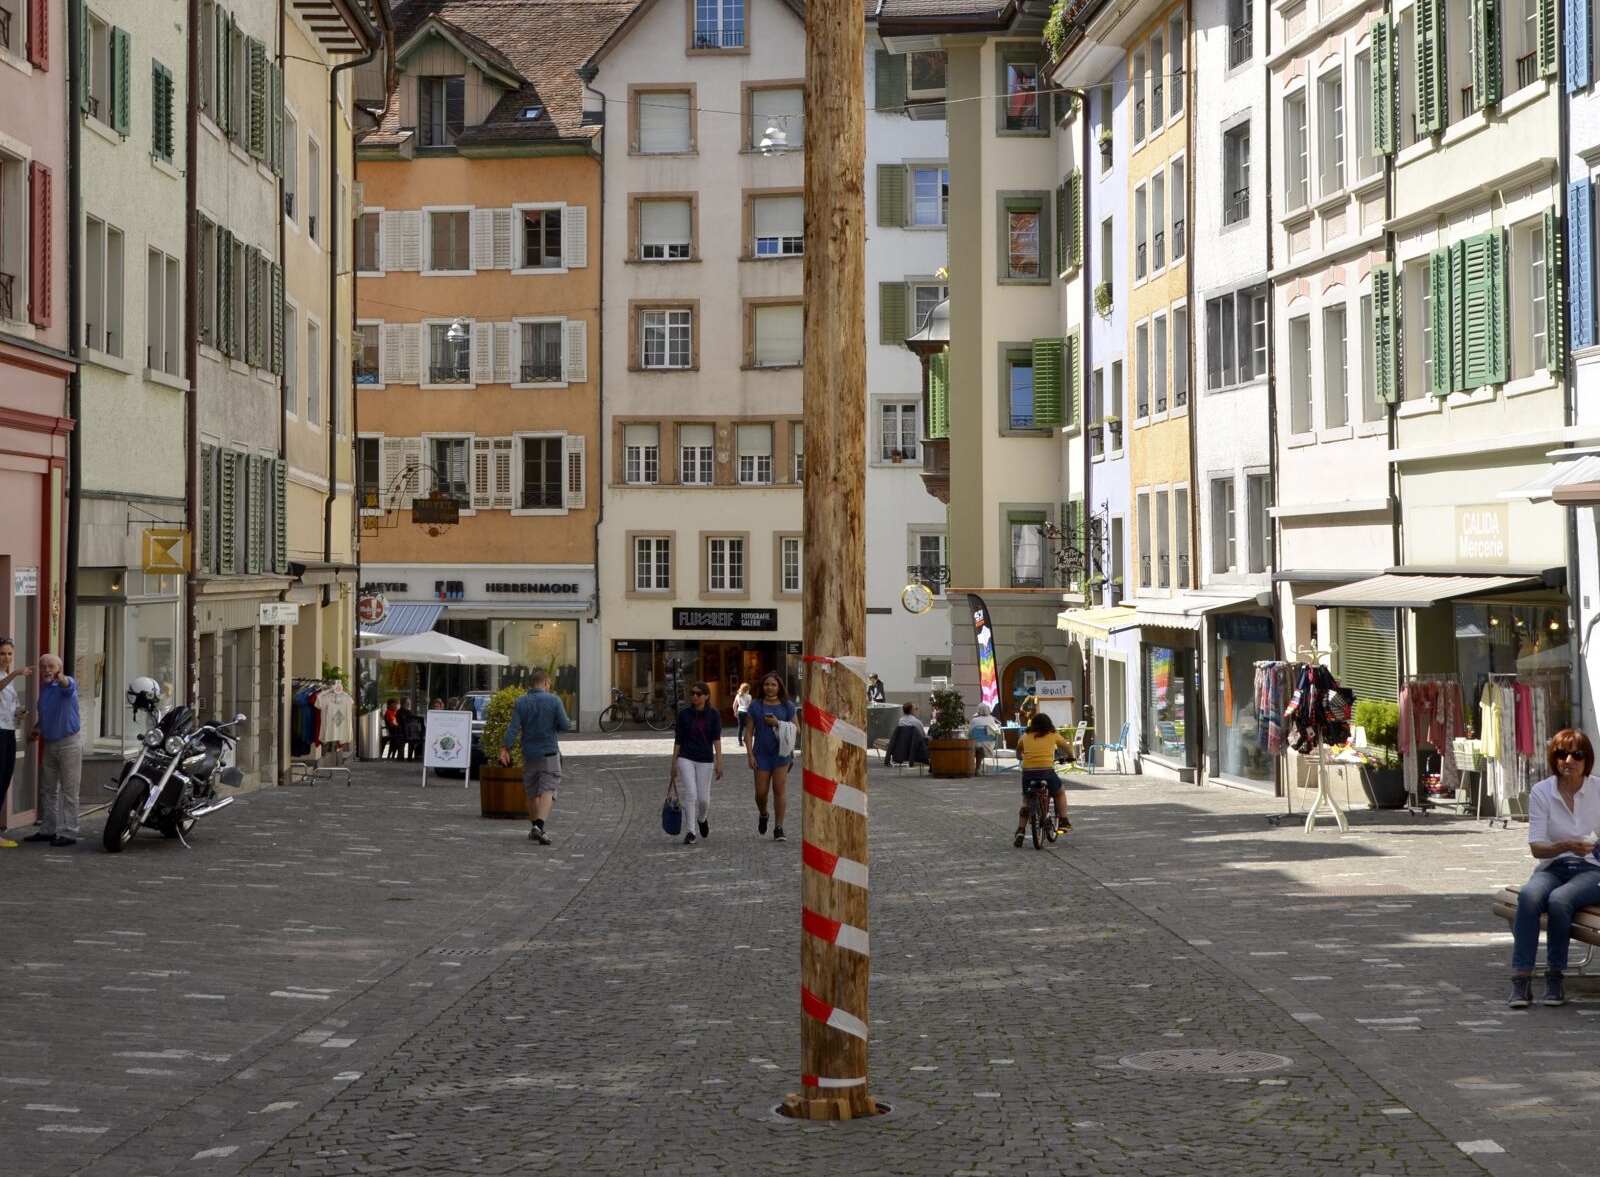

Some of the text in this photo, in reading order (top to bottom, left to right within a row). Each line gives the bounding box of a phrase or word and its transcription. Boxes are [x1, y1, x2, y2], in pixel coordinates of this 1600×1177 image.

[1463, 512, 1500, 534] CALIDA
[1459, 535, 1504, 558] Mercerie
[364, 582, 408, 592] MEYER
[485, 583, 580, 593] HERRENMODE
[741, 612, 770, 620] FOTOGRAFIE
